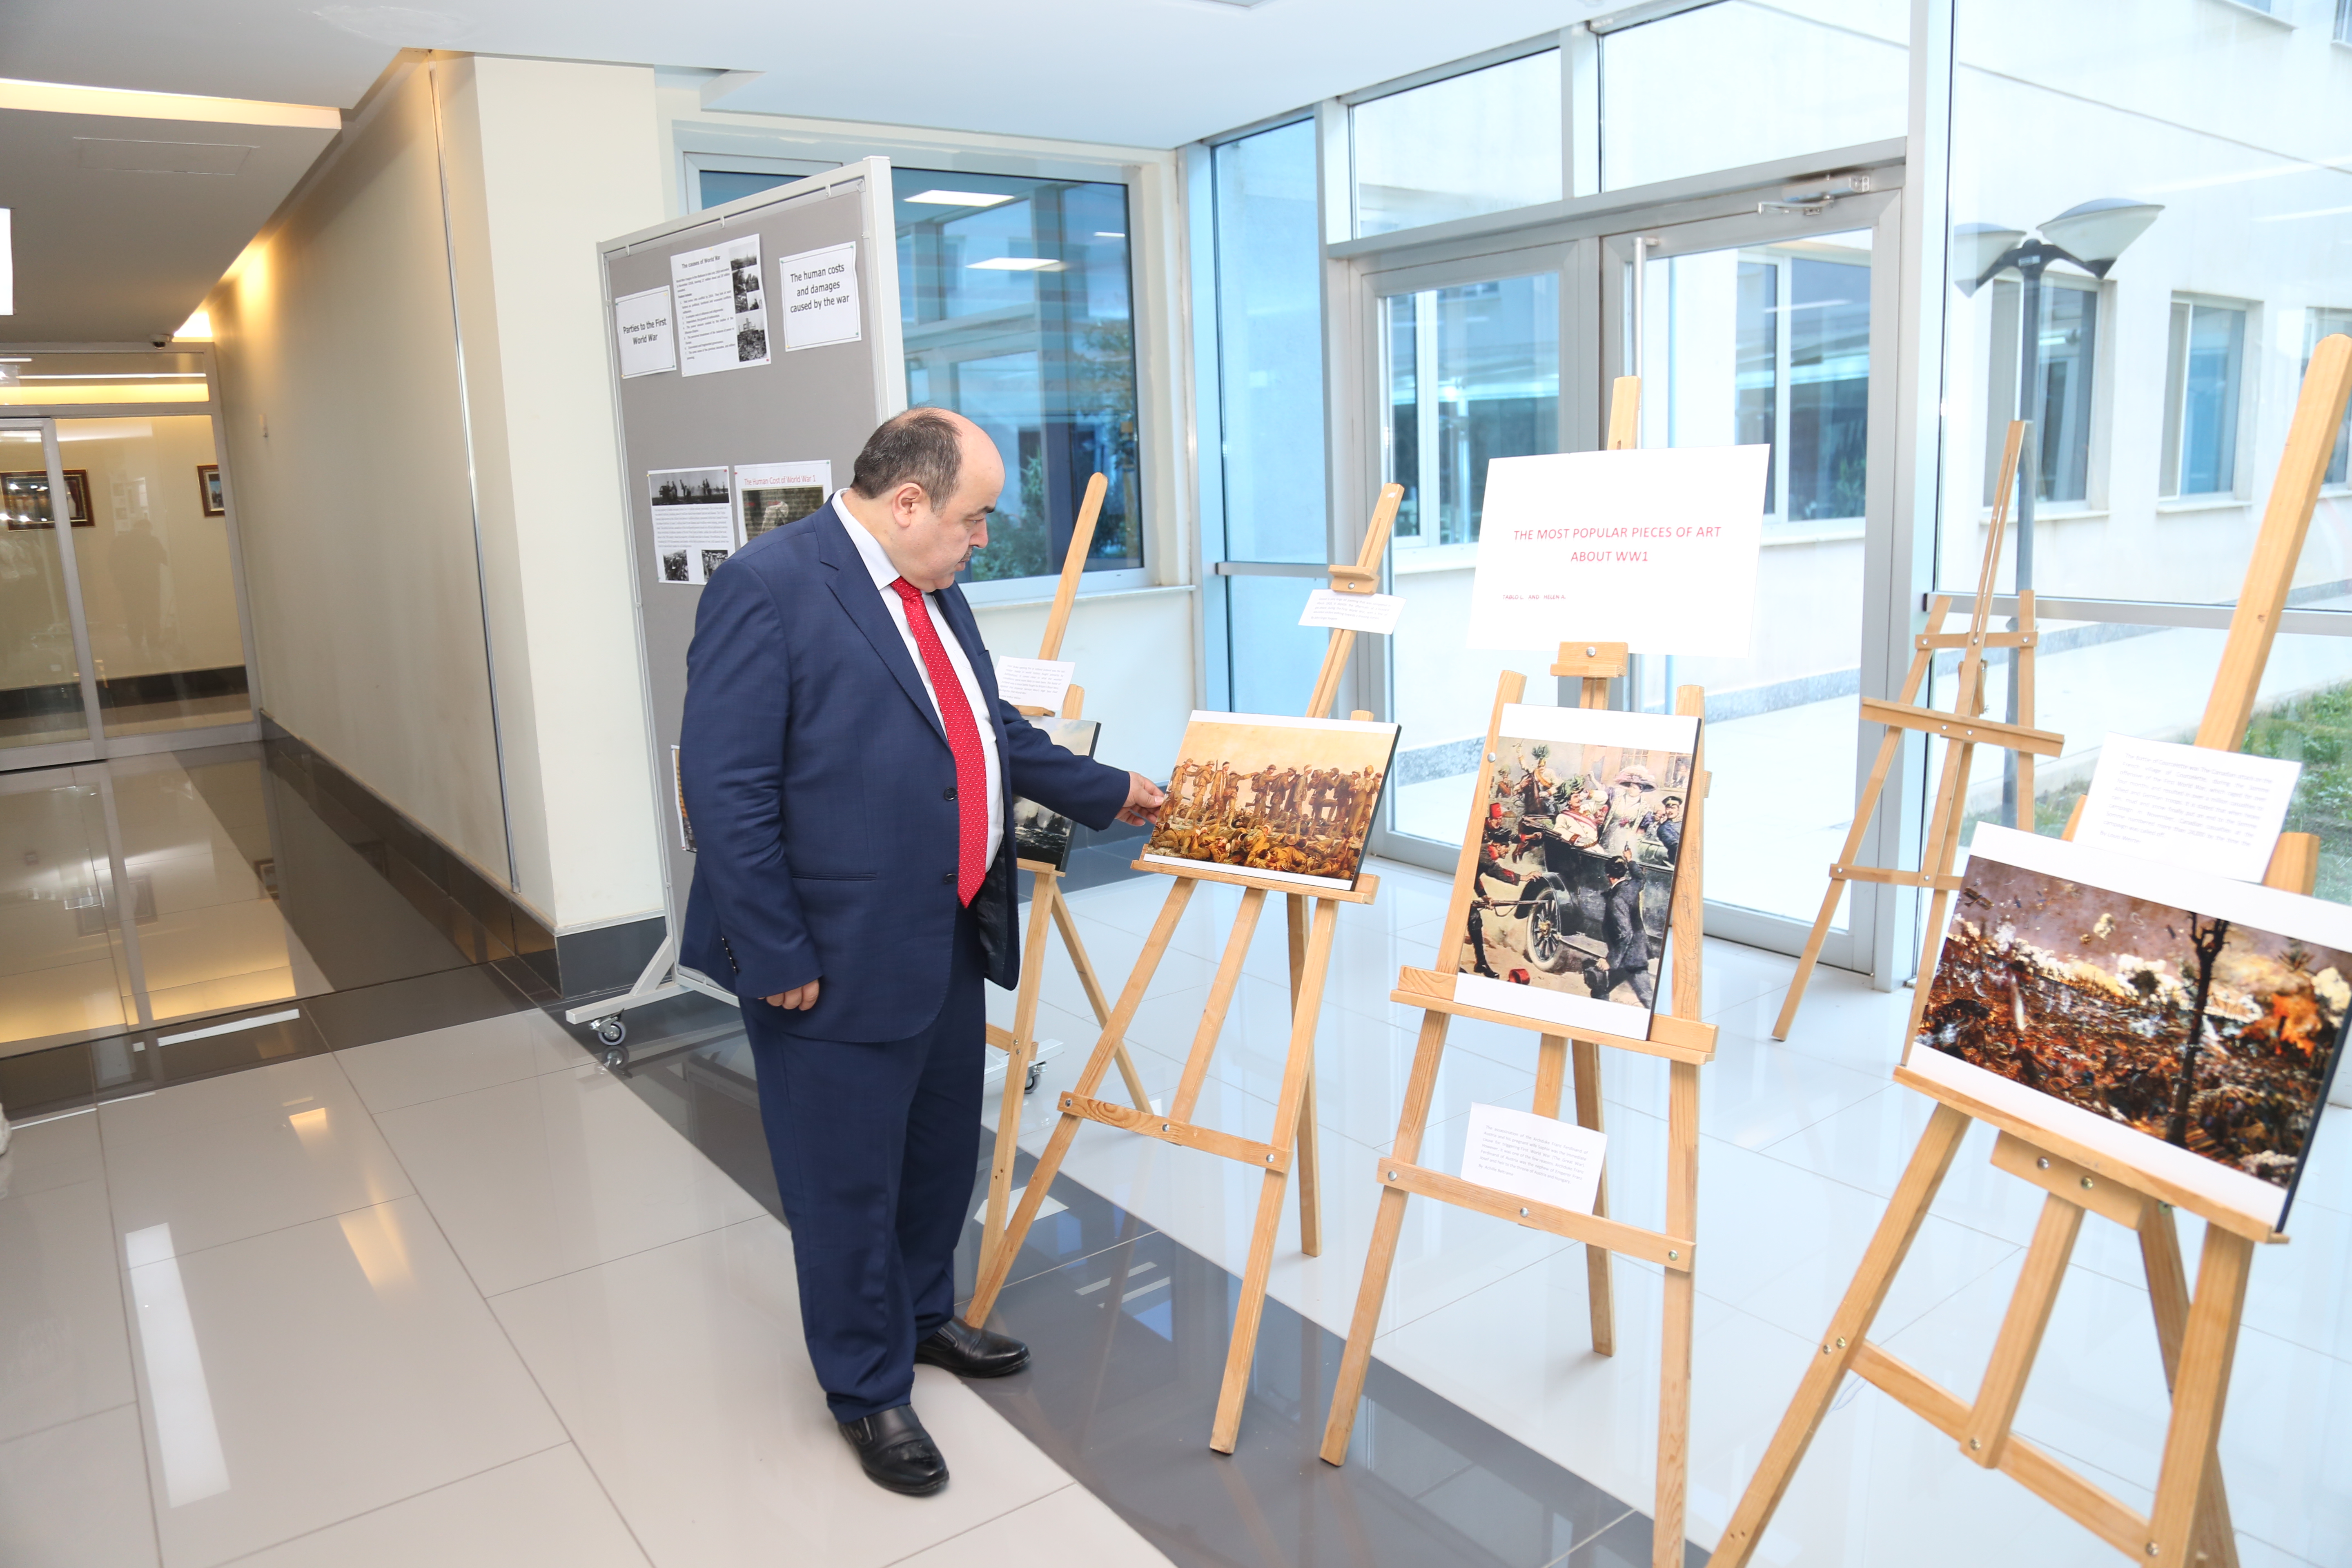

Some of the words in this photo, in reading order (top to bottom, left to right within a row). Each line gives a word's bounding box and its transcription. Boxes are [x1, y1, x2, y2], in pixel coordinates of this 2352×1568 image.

[790, 273, 802, 283] The
[803, 269, 826, 280] human
[828, 264, 844, 274] costs
[797, 286, 808, 296] and
[811, 281, 840, 292] damages
[790, 301, 812, 313] caused
[814, 300, 822, 310] by
[824, 297, 835, 307] the
[836, 295, 849, 304] war
[623, 325, 639, 334] Parties
[646, 321, 654, 329] the
[655, 318, 666, 327] First
[633, 335, 647, 345] World
[648, 334, 658, 342] War
[1514, 530, 1533, 539] THE
[1537, 529, 1569, 539] MOST
[1573, 528, 1628, 538] POPULAR
[1632, 527, 1672, 538] PIECES
[1676, 527, 1693, 537] OF
[1696, 526, 1722, 537] ART
[1570, 551, 1612, 562] ABOUT
[1616, 551, 1648, 561] WW1
[1563, 1145, 1582, 1153] Ferdinand
